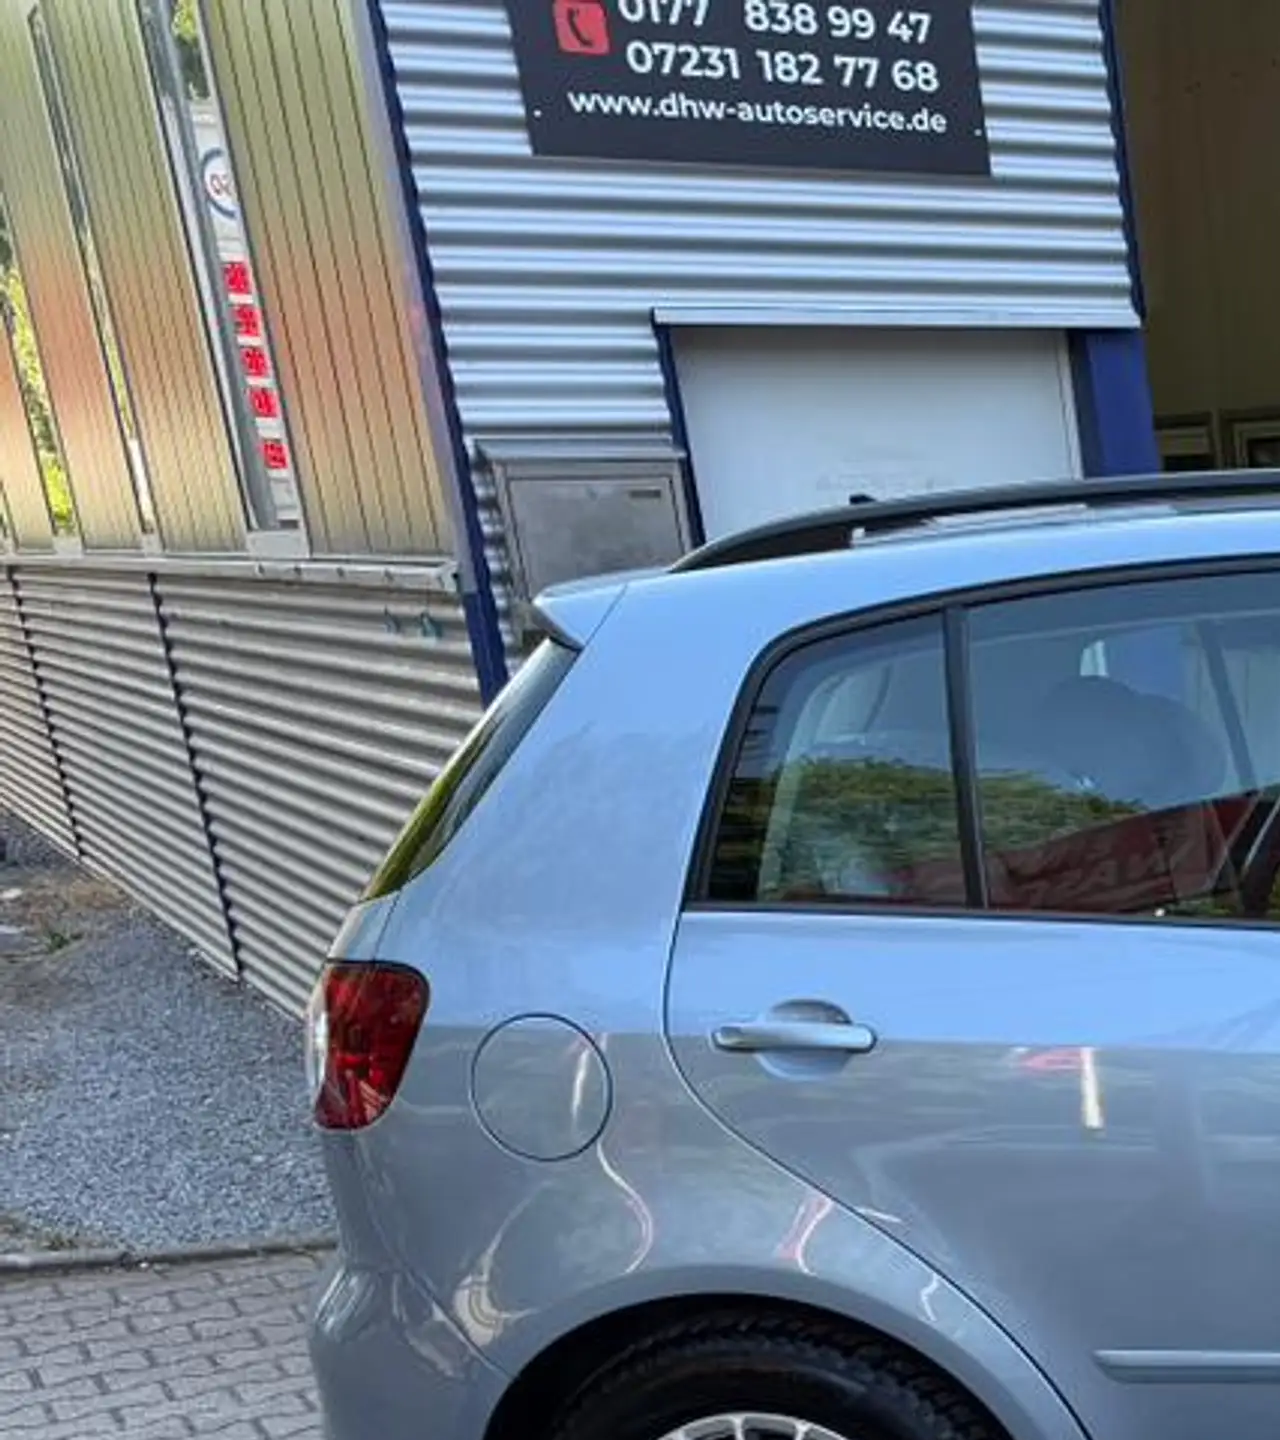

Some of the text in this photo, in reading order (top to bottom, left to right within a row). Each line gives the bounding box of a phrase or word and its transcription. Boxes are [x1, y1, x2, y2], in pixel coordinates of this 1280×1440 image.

[617, 0, 931, 44] 0177 838 99 47
[626, 40, 940, 92] 07231 182 77 68
[567, 91, 947, 133] www.dhw-autoservice.de
